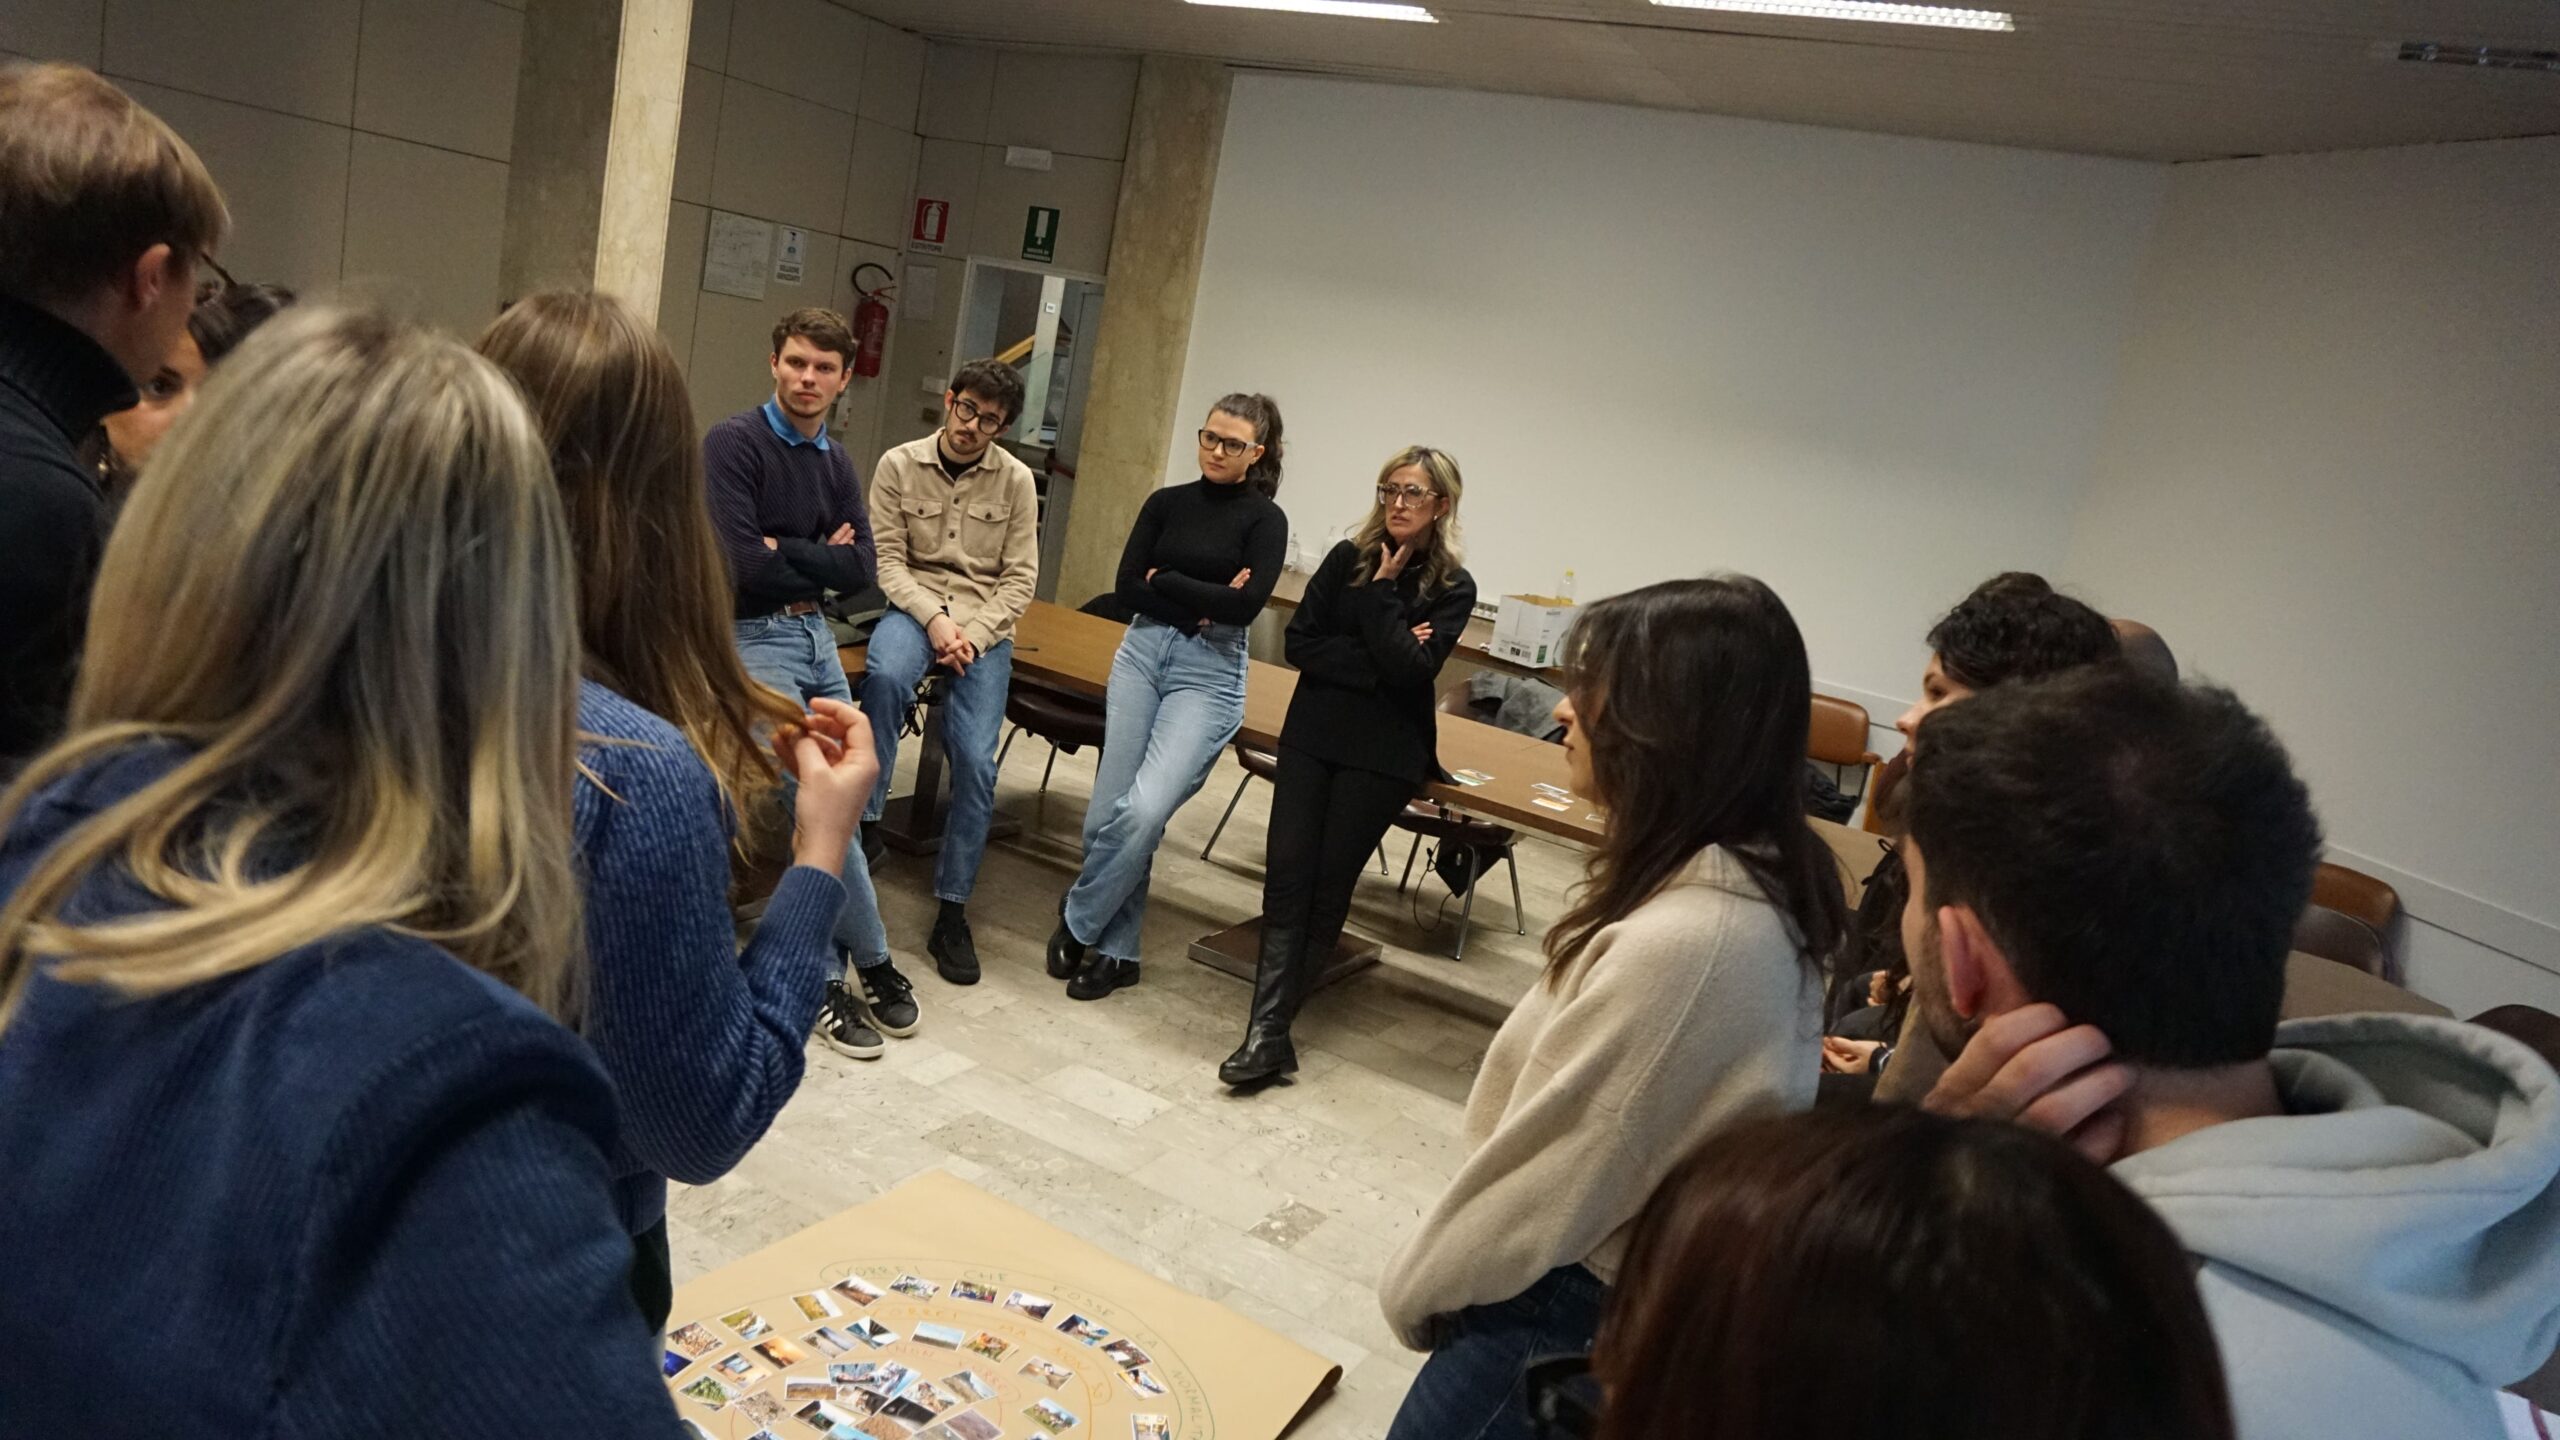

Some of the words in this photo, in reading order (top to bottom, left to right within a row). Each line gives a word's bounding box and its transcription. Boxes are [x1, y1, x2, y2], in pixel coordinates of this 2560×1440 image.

[836, 1265, 921, 1278] VORREI
[963, 1269, 1008, 1281] CHE
[1052, 1285, 1116, 1318] FOSSE
[1135, 1332, 1158, 1349] LA
